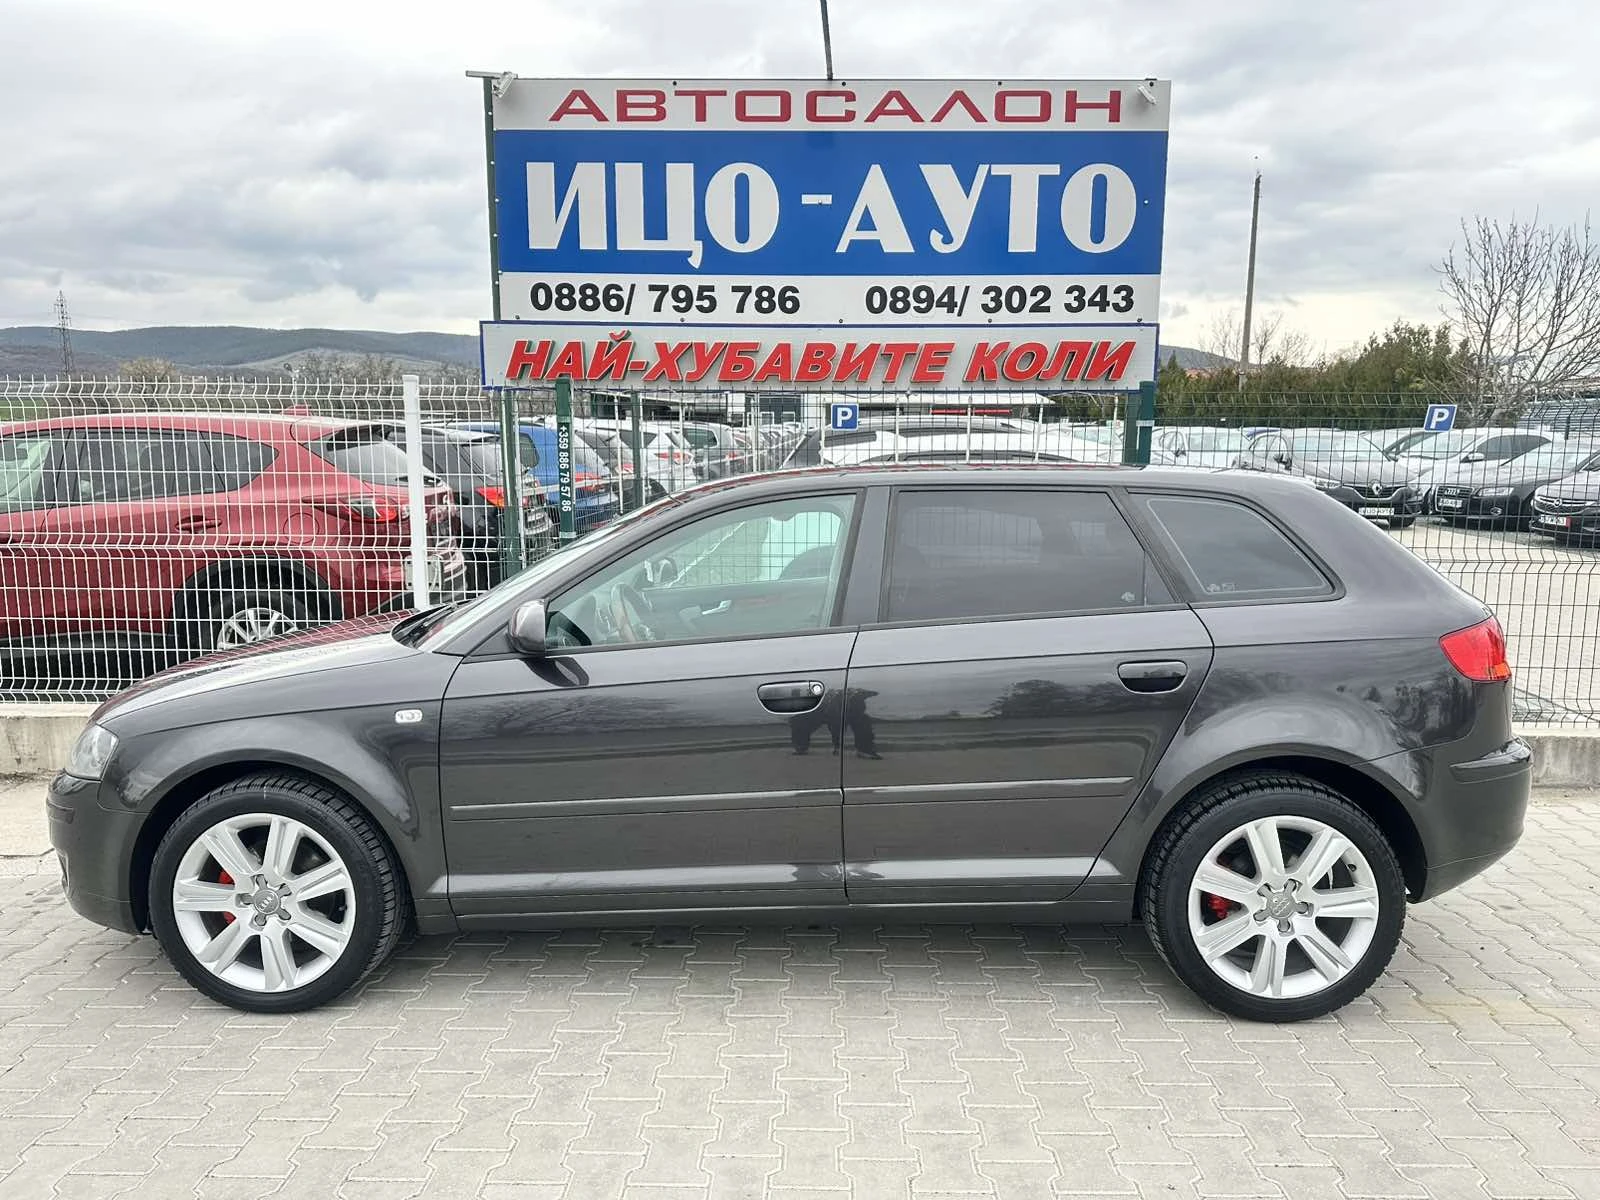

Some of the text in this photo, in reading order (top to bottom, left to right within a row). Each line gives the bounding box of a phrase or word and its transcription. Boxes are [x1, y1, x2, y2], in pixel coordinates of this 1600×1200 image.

[550, 90, 1122, 123] АВТОСАЛОН
[530, 282, 801, 315] 0886/ 795 786
[865, 284, 1135, 316] 0894/ 302 343
[505, 330, 1137, 383] НАЙ-ХУБАВИТЕ КОЛИ
[837, 407, 853, 427] P
[1430, 408, 1450, 429] P
[558, 425, 572, 512] +359 886 79 57 86
